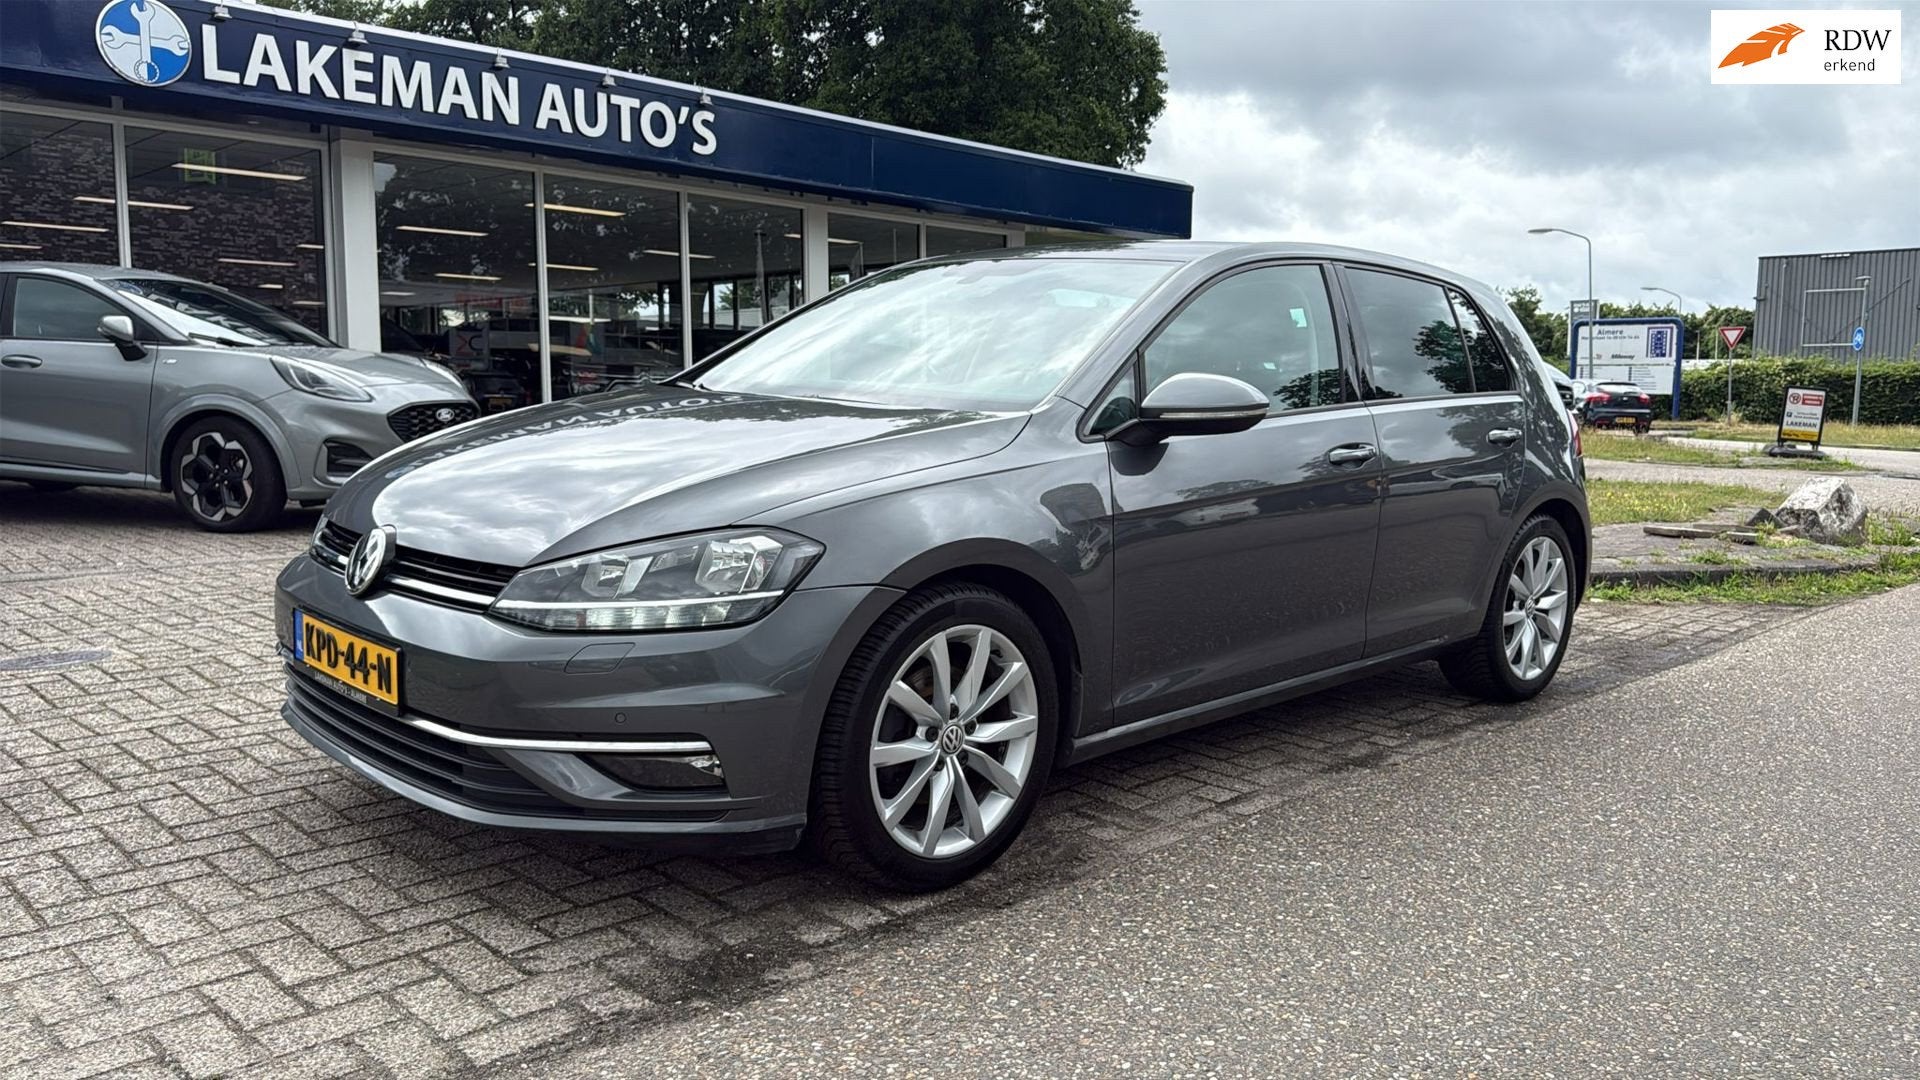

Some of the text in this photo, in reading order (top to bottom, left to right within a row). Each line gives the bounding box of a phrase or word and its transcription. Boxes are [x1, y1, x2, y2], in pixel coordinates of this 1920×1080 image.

[202, 23, 718, 156] LAKEMAN AUTO'S
[305, 622, 392, 695] KPD-44-N
